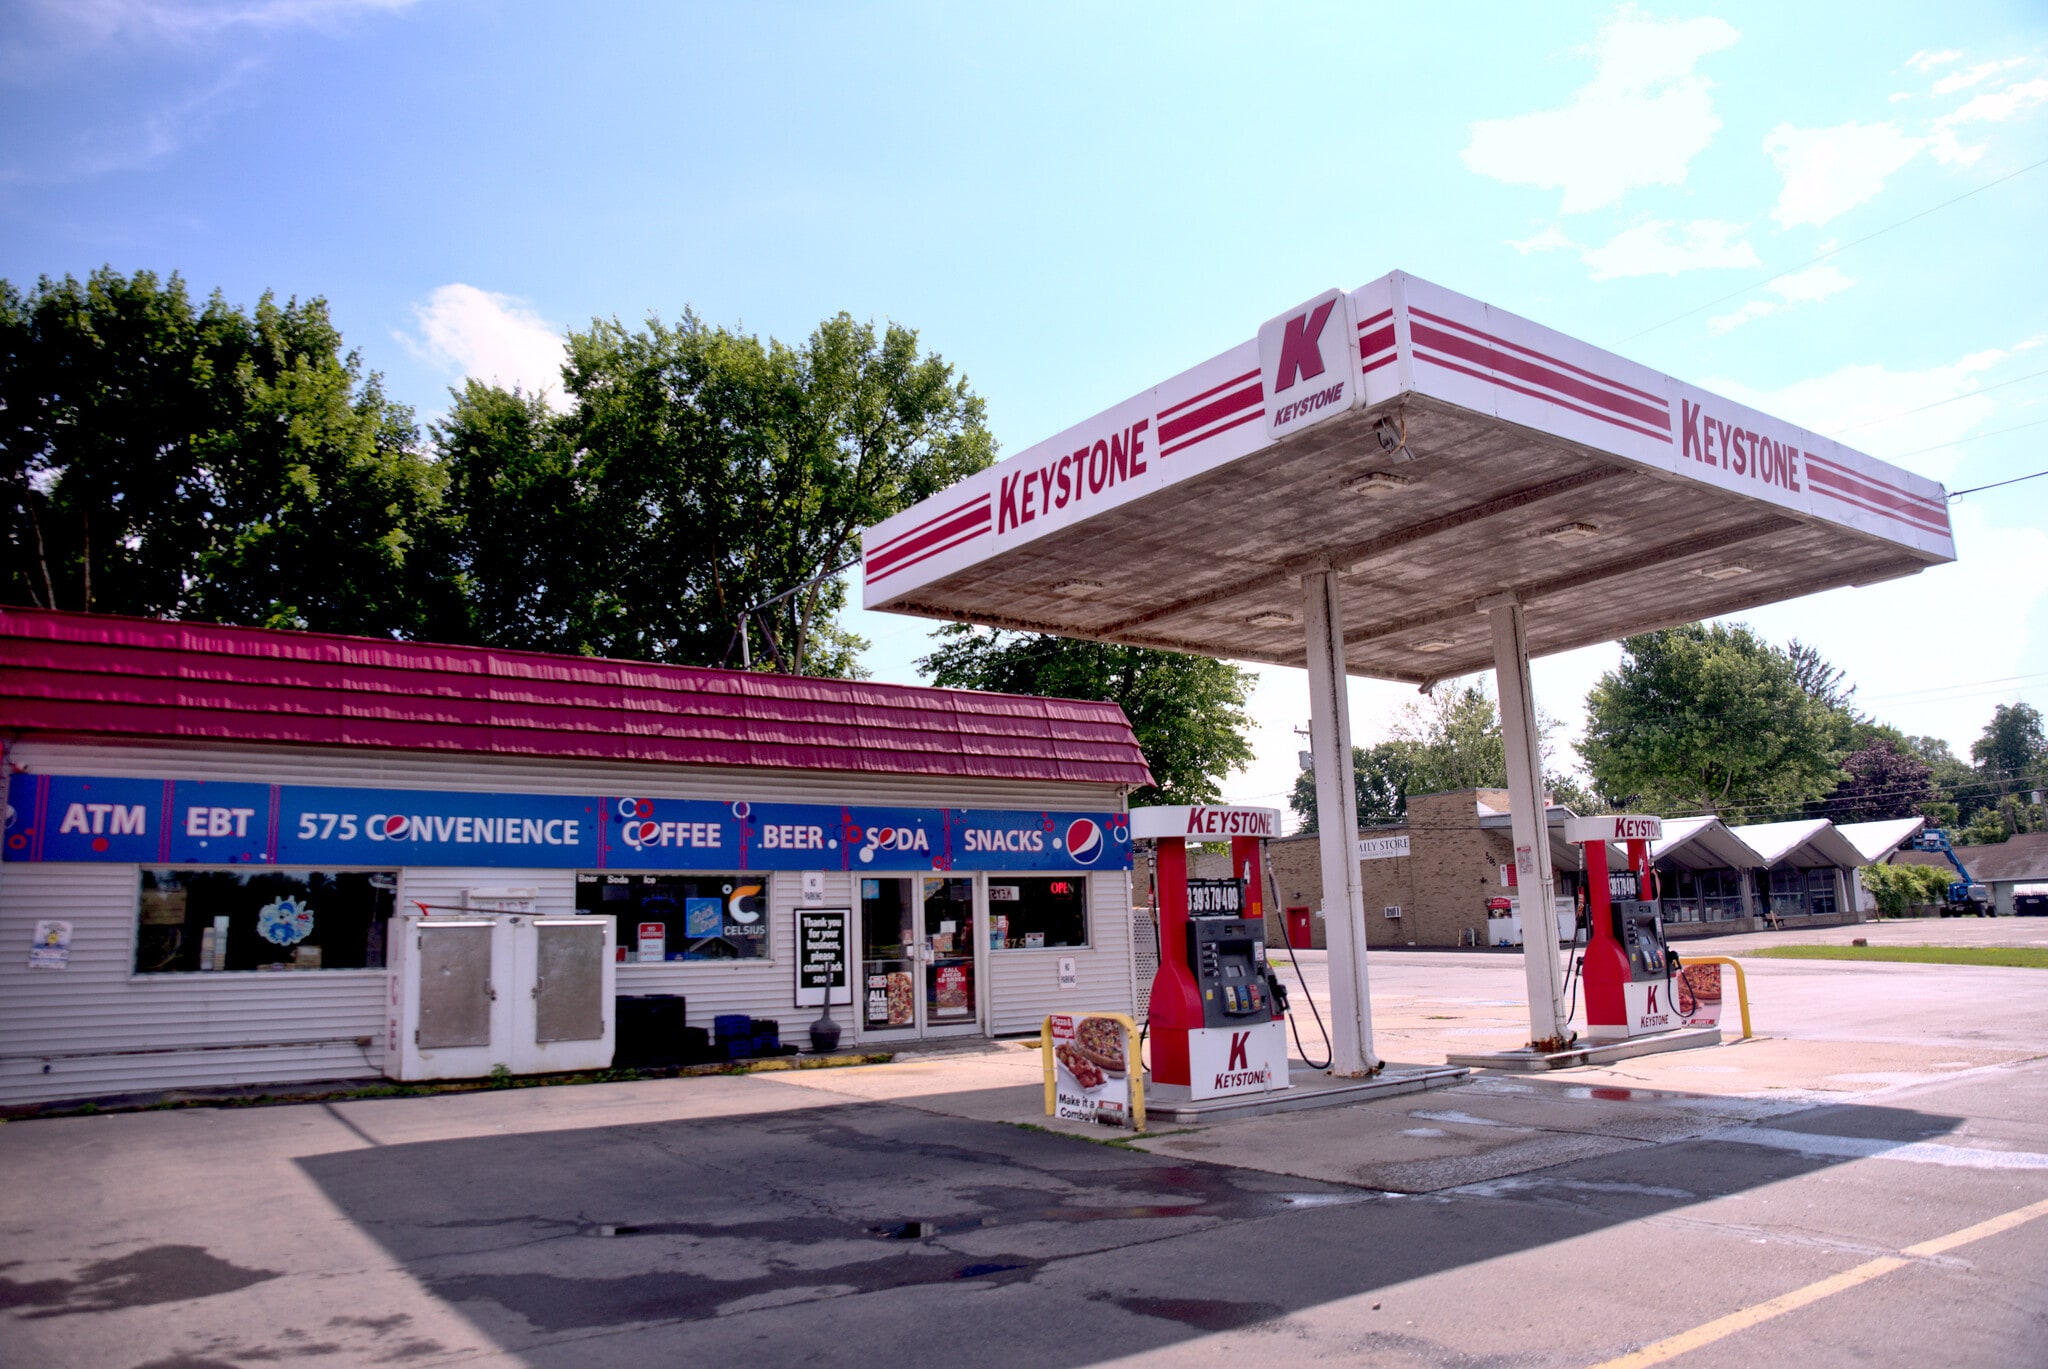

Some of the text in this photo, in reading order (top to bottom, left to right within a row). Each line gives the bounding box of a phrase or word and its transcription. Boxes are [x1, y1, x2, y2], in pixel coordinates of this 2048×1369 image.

[1274, 298, 1336, 394] K
[1273, 381, 1344, 428] KEYSTONE
[1682, 398, 1800, 493] KEYSTONE
[997, 418, 1149, 535] KEYSTONE
[60, 803, 146, 835] ATM
[186, 806, 255, 837] EBT
[297, 813, 358, 840] 575
[1187, 807, 1273, 834] KEYSTONE
[763, 825, 823, 849] BEER
[964, 829, 1043, 852] SNACKS
[1380, 839, 1408, 850] STORE
[578, 874, 656, 884] Beer Soda Ice
[1050, 882, 1074, 894] OPEN
[1204, 887, 1221, 911] 379
[1222, 886, 1238, 910] 409
[724, 925, 765, 936] CELSIUS
[803, 917, 842, 930] Thank you
[808, 928, 839, 942] for your
[806, 940, 841, 950] business,
[810, 951, 835, 963] please
[803, 963, 824, 972] come
[812, 972, 833, 983] soo!
[869, 990, 887, 1001] ALL
[1647, 985, 1658, 1014] K
[1641, 1014, 1669, 1029] KEYSTONE
[1228, 1031, 1251, 1071] K
[1214, 1071, 1264, 1090] KEYSTONE
[1058, 1093, 1080, 1106] Make
[1082, 1096, 1088, 1108] it
